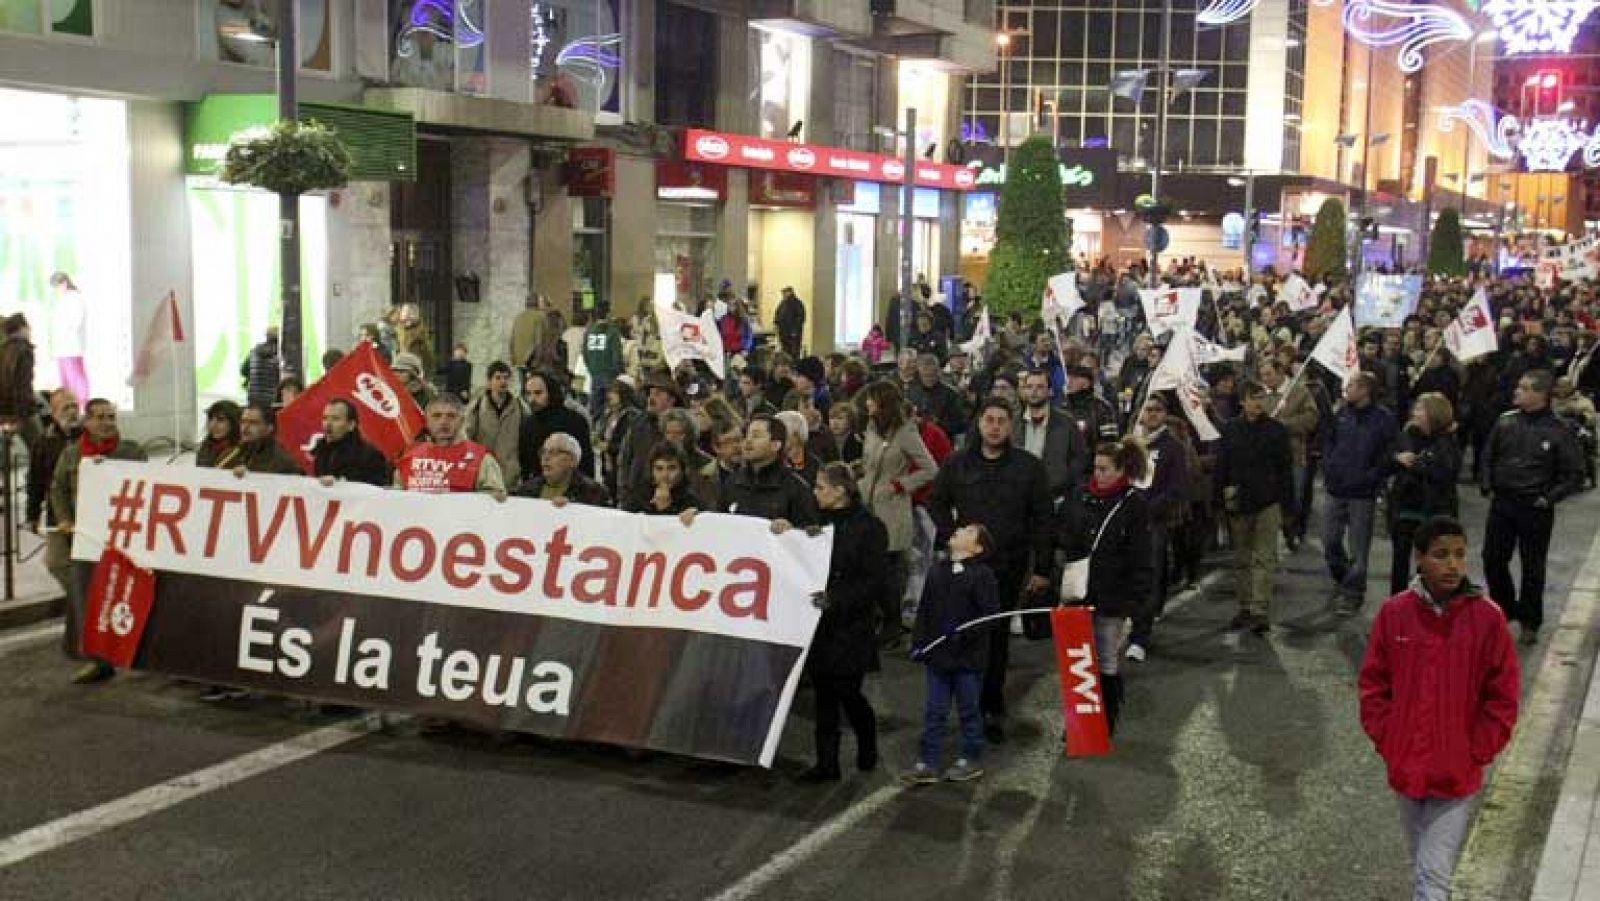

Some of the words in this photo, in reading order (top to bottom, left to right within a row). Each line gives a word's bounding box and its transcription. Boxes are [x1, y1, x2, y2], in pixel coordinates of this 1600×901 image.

[587, 333, 607, 351] 23
[106, 479, 770, 621] #RTVVnoestanca
[238, 589, 313, 678] És
[334, 617, 392, 691] la
[416, 631, 574, 716] teua
